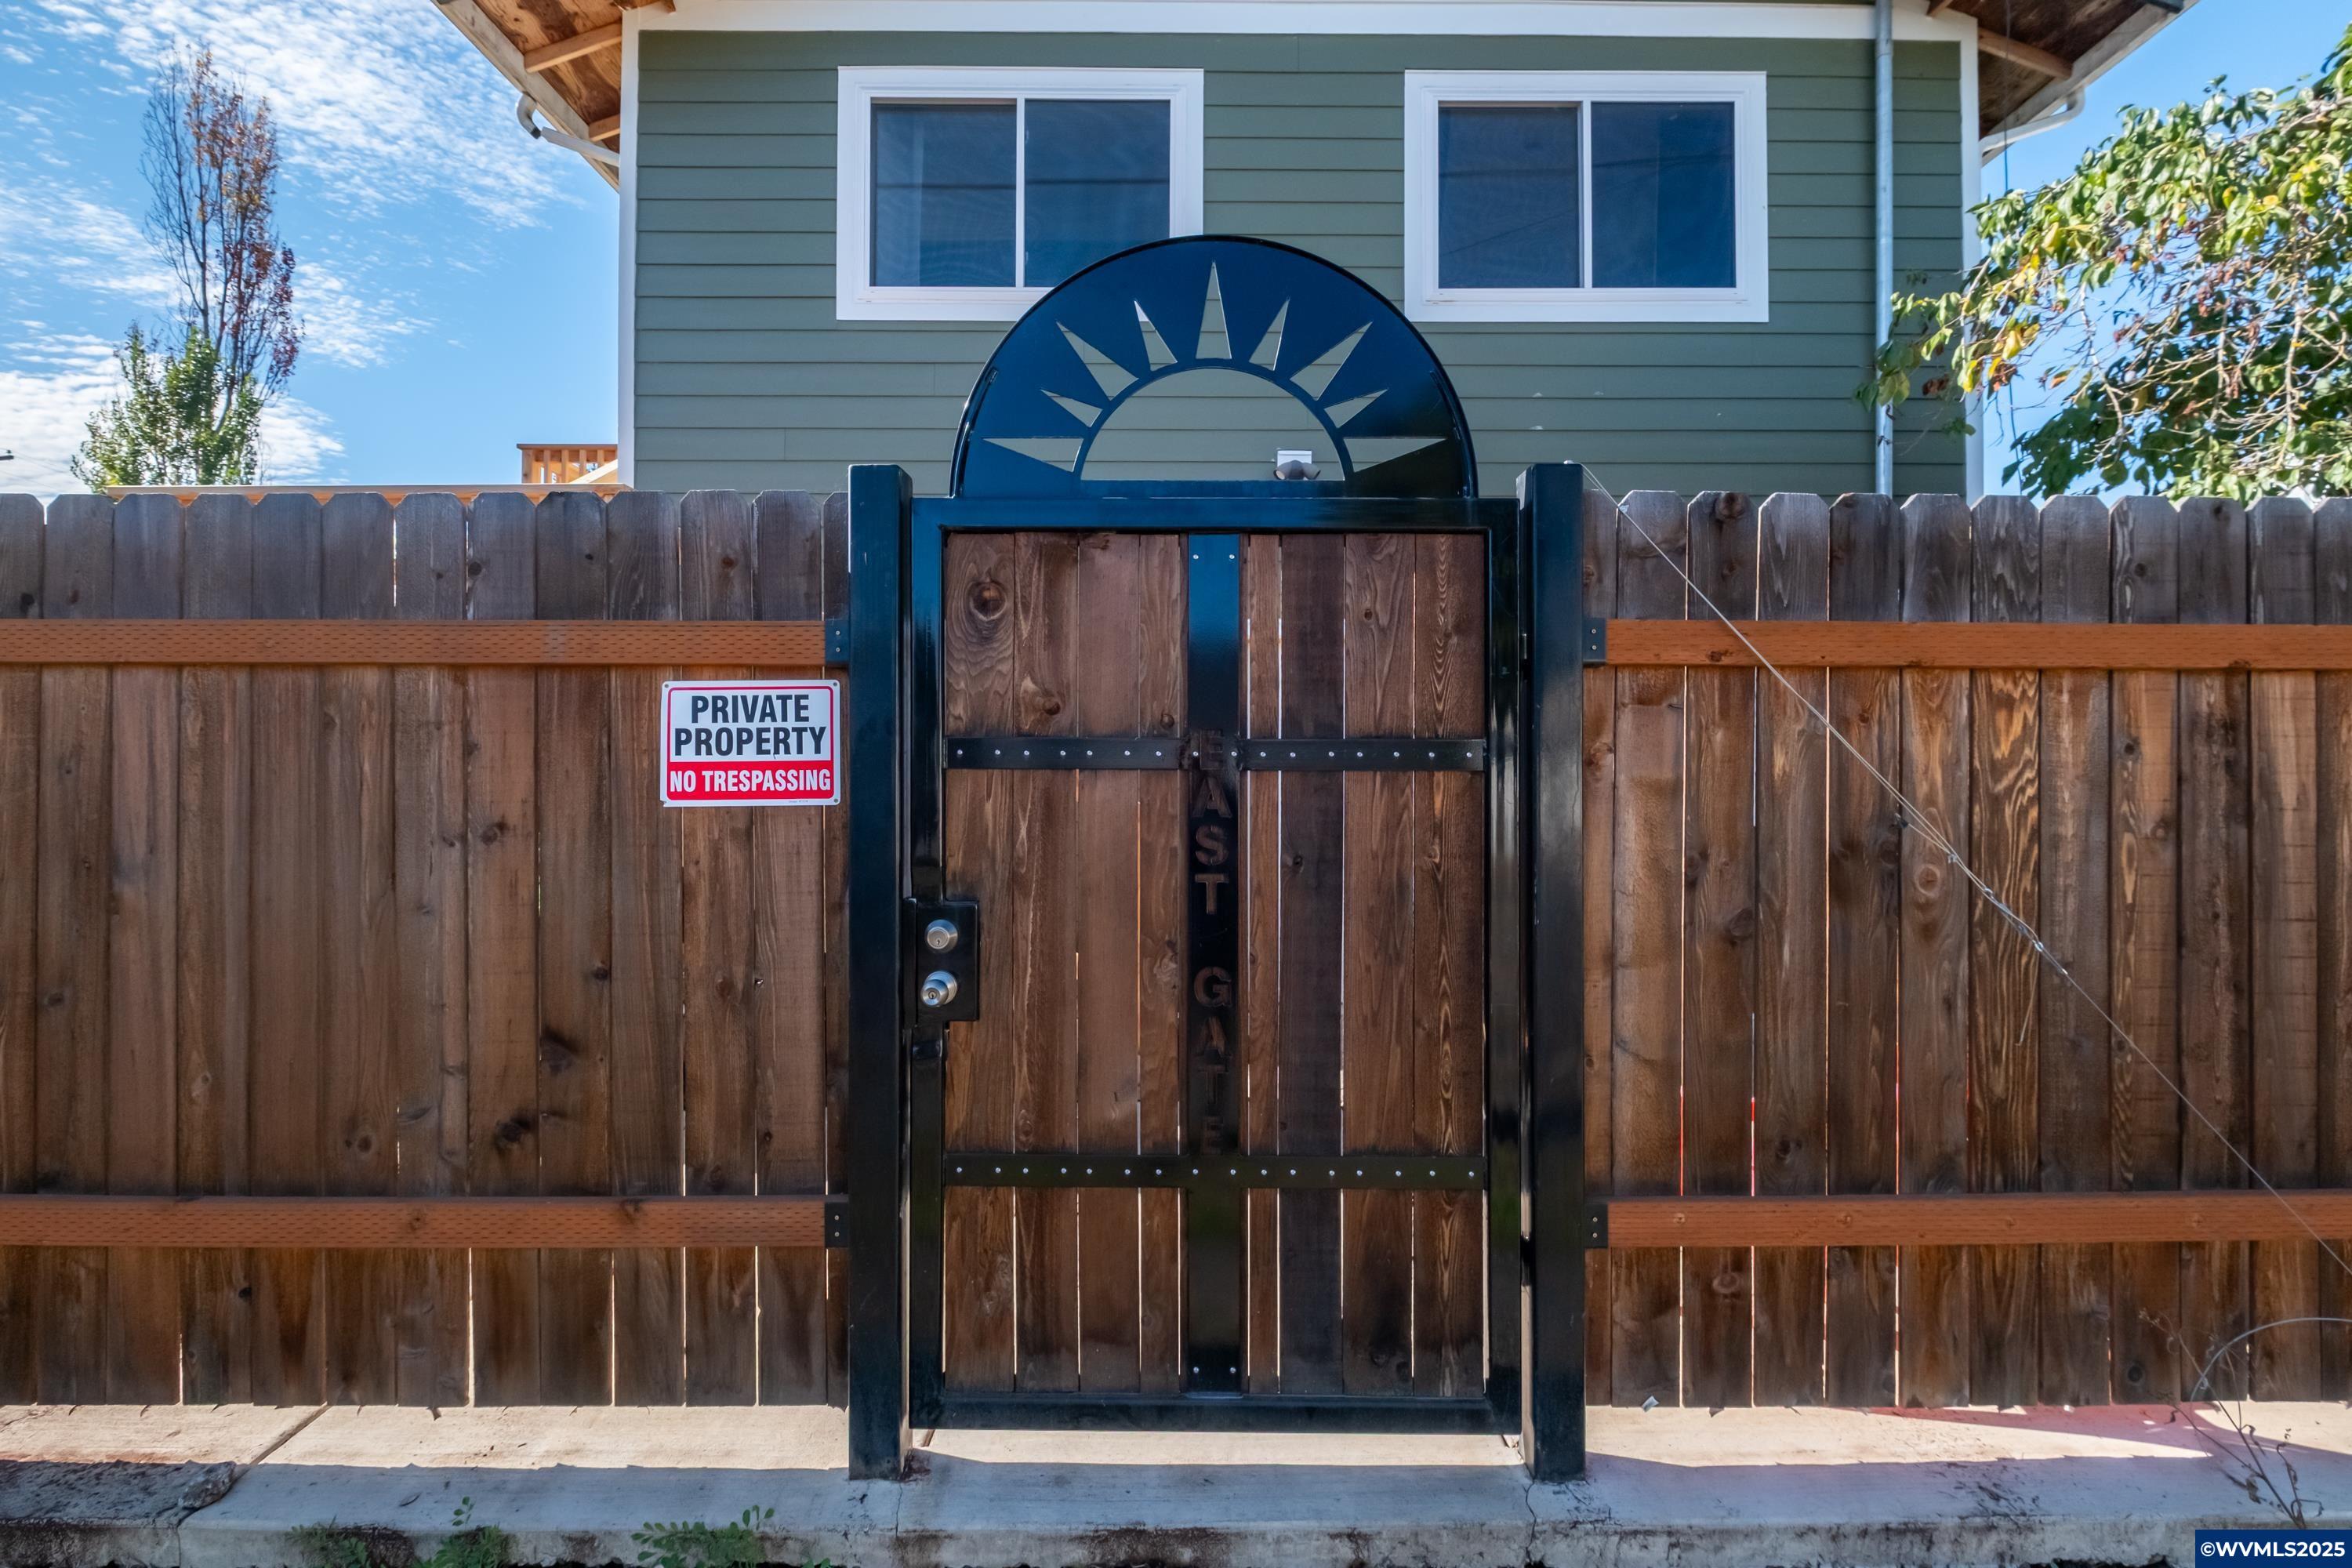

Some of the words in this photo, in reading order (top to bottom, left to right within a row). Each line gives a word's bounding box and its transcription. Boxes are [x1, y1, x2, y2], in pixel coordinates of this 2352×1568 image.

[691, 694, 810, 724] PRIVATE
[674, 726, 827, 757] PROPERTY
[670, 770, 697, 793] NO
[702, 768, 831, 792] TRESPASSING
[1192, 728, 1232, 915] EAST
[1193, 966, 1233, 1155] GATE
